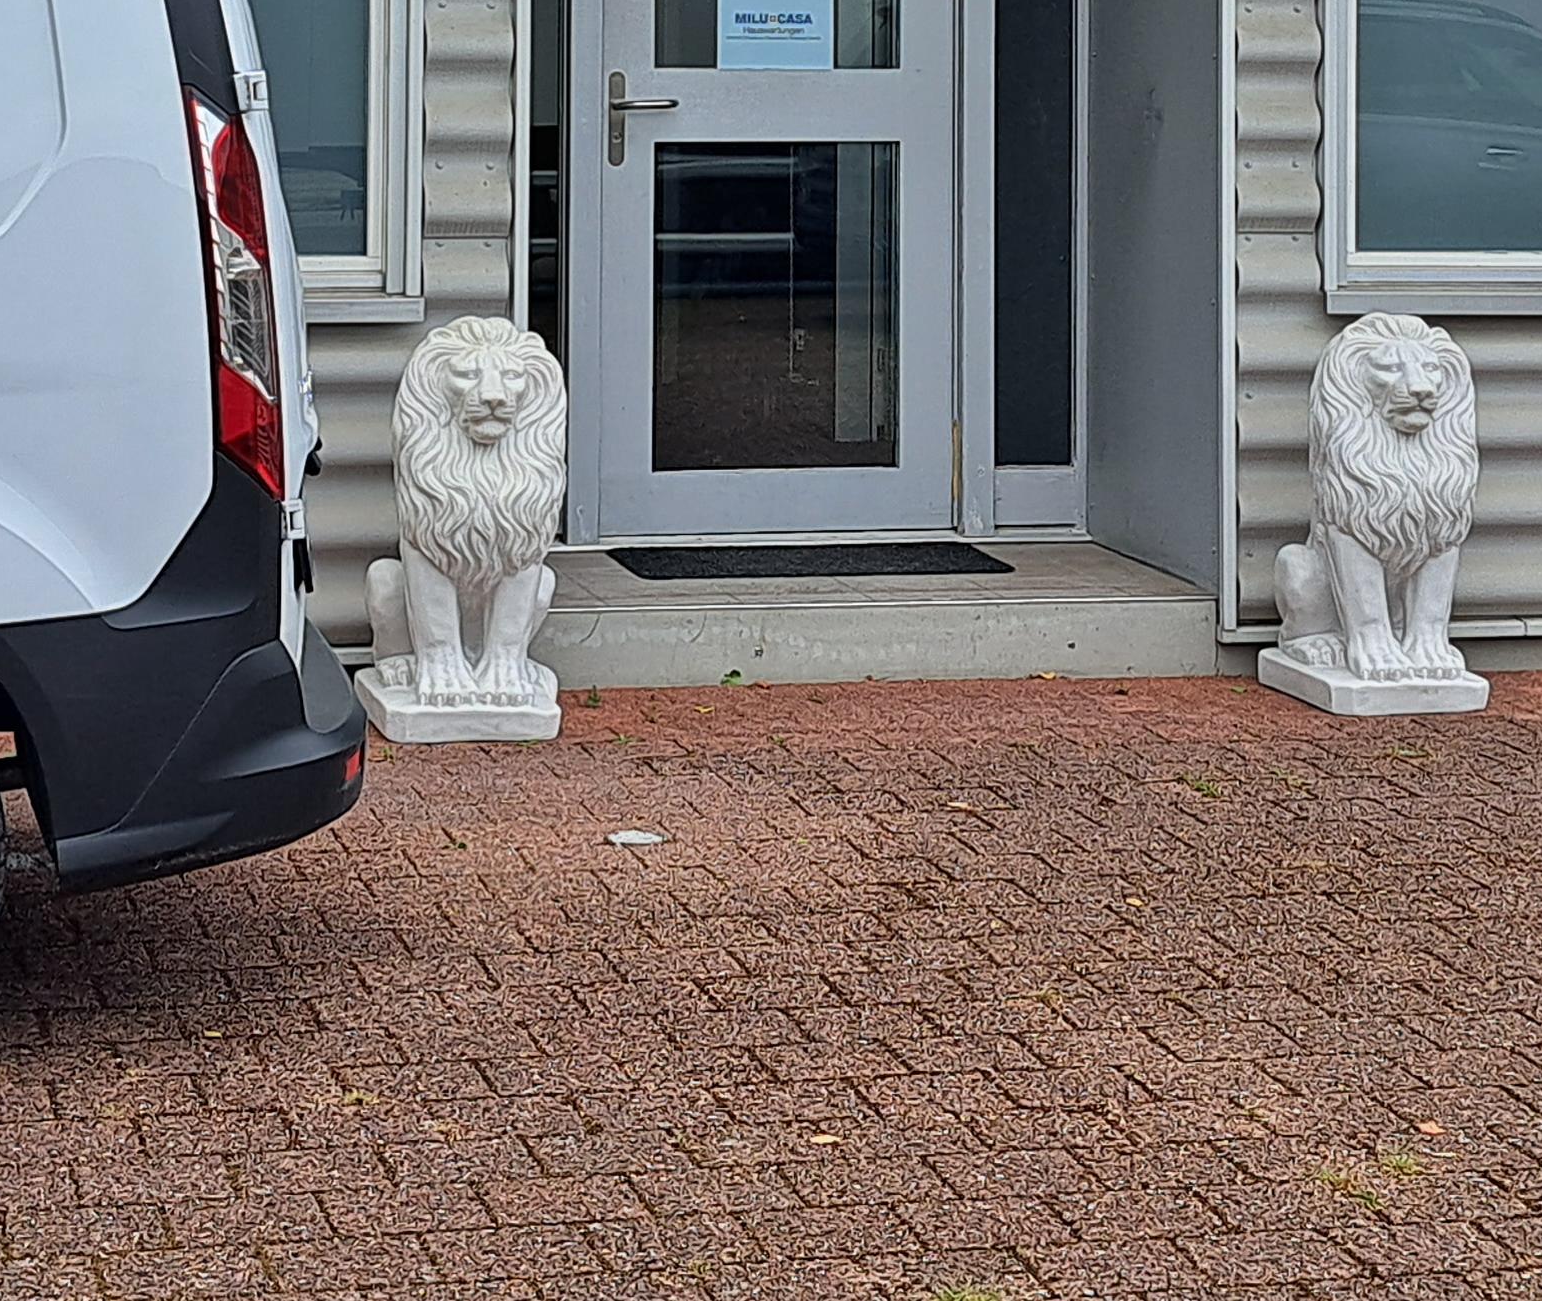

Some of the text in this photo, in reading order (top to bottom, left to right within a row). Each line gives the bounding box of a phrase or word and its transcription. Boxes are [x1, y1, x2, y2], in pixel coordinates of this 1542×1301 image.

[735, 13, 813, 24] MILU CASA
[743, 27, 805, 35] Hauswartungen
